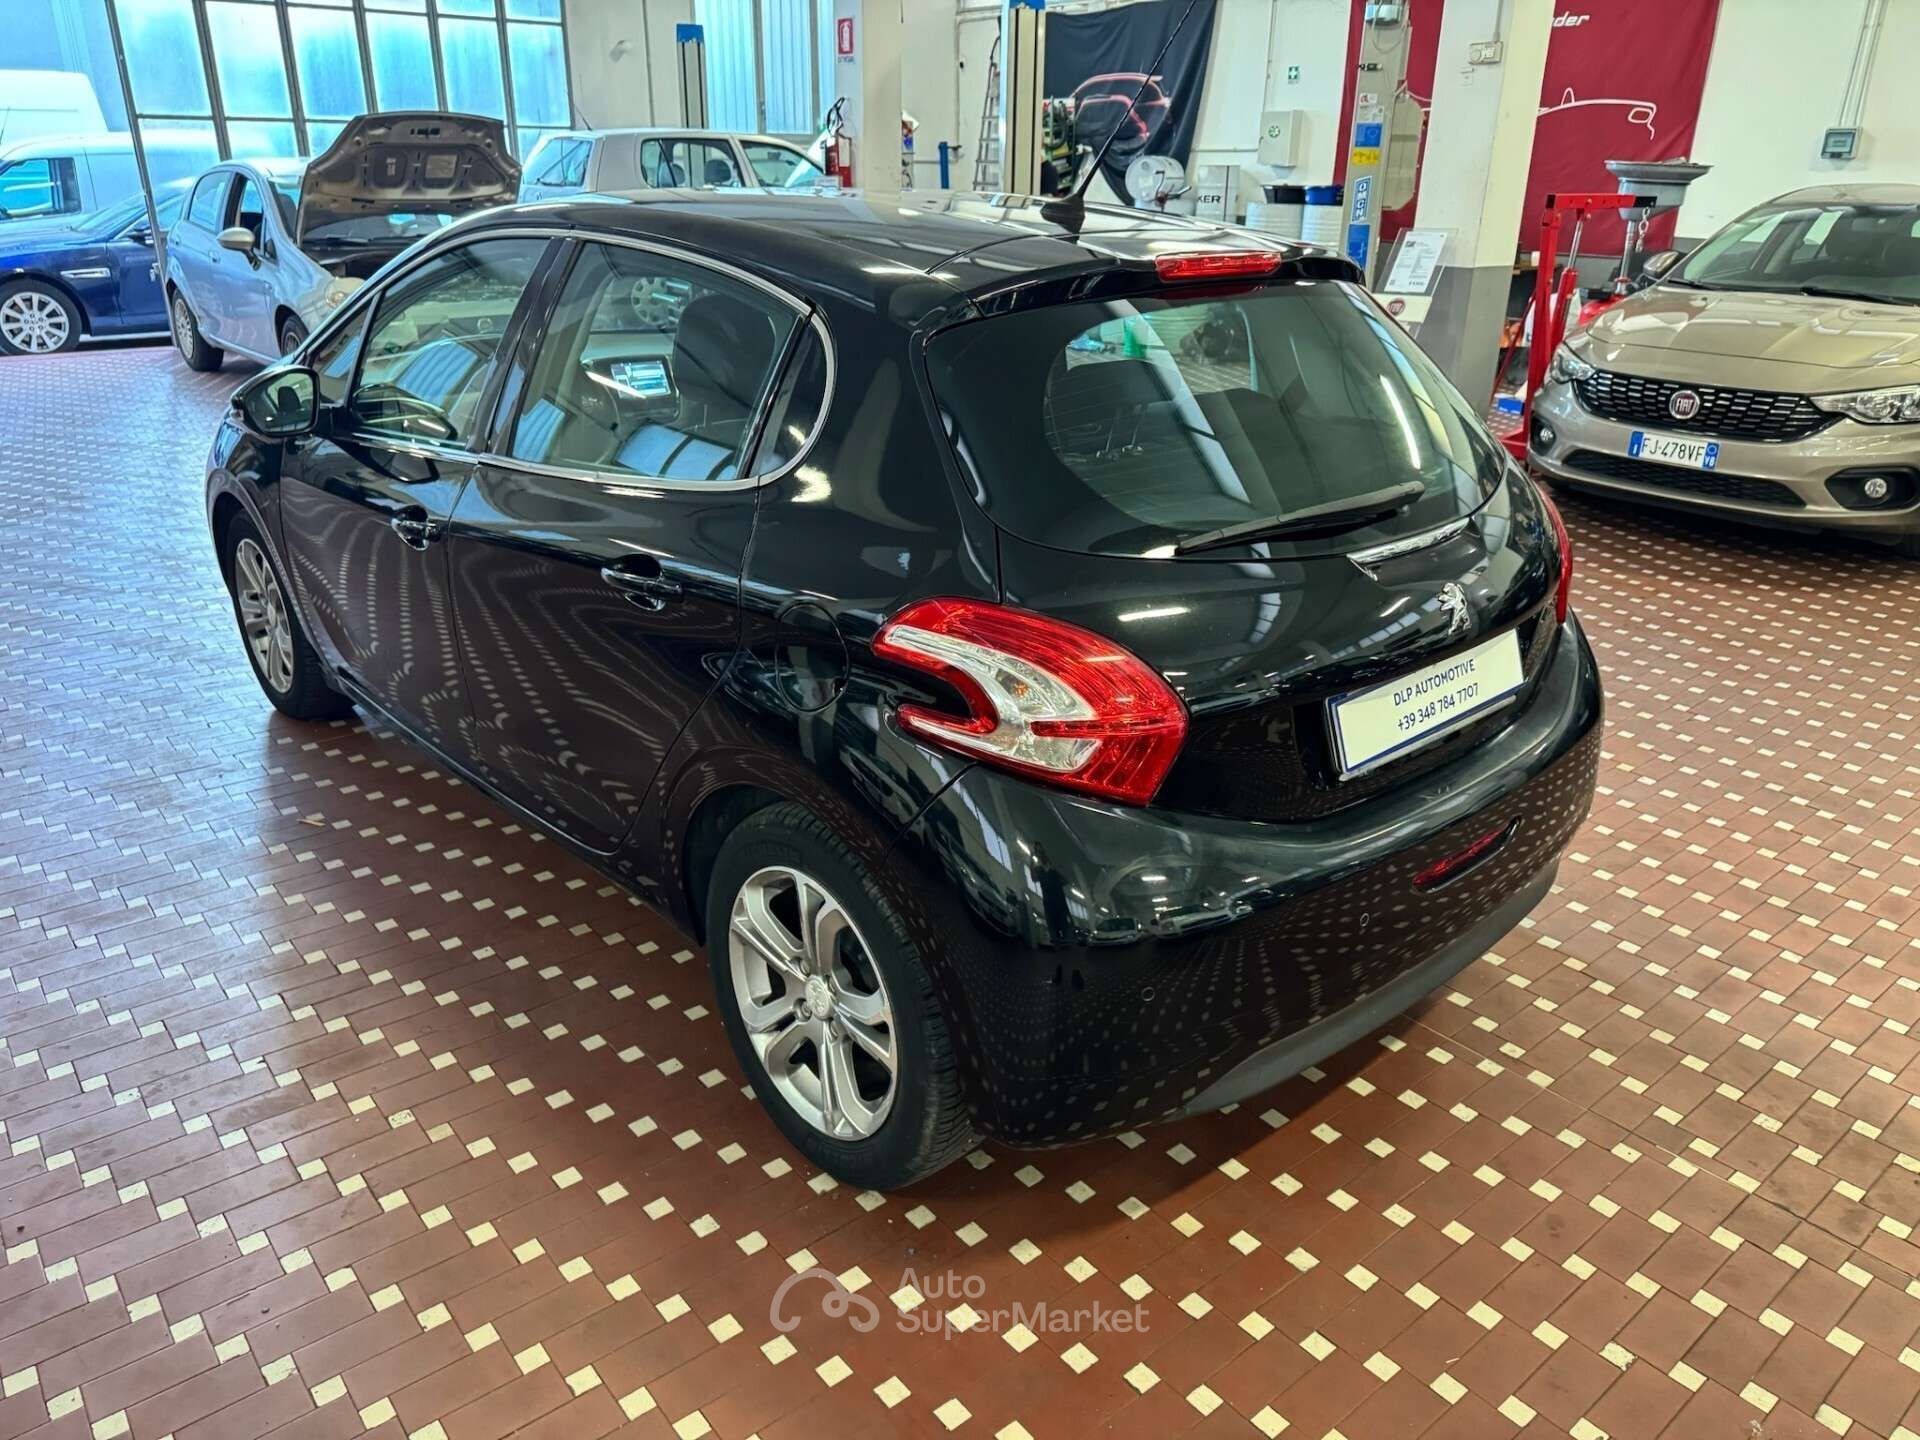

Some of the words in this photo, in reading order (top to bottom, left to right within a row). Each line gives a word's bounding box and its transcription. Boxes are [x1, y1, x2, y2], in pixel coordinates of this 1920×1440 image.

[1552, 11, 1590, 27] der
[1676, 397, 1695, 413] FIAT
[1393, 687, 1412, 706] DLP
[1415, 659, 1475, 697] AUTOMOTIVE
[1398, 712, 1416, 731] +39
[1417, 701, 1436, 723] 348
[1437, 694, 1455, 713] 784
[1456, 682, 1479, 704] 7707
